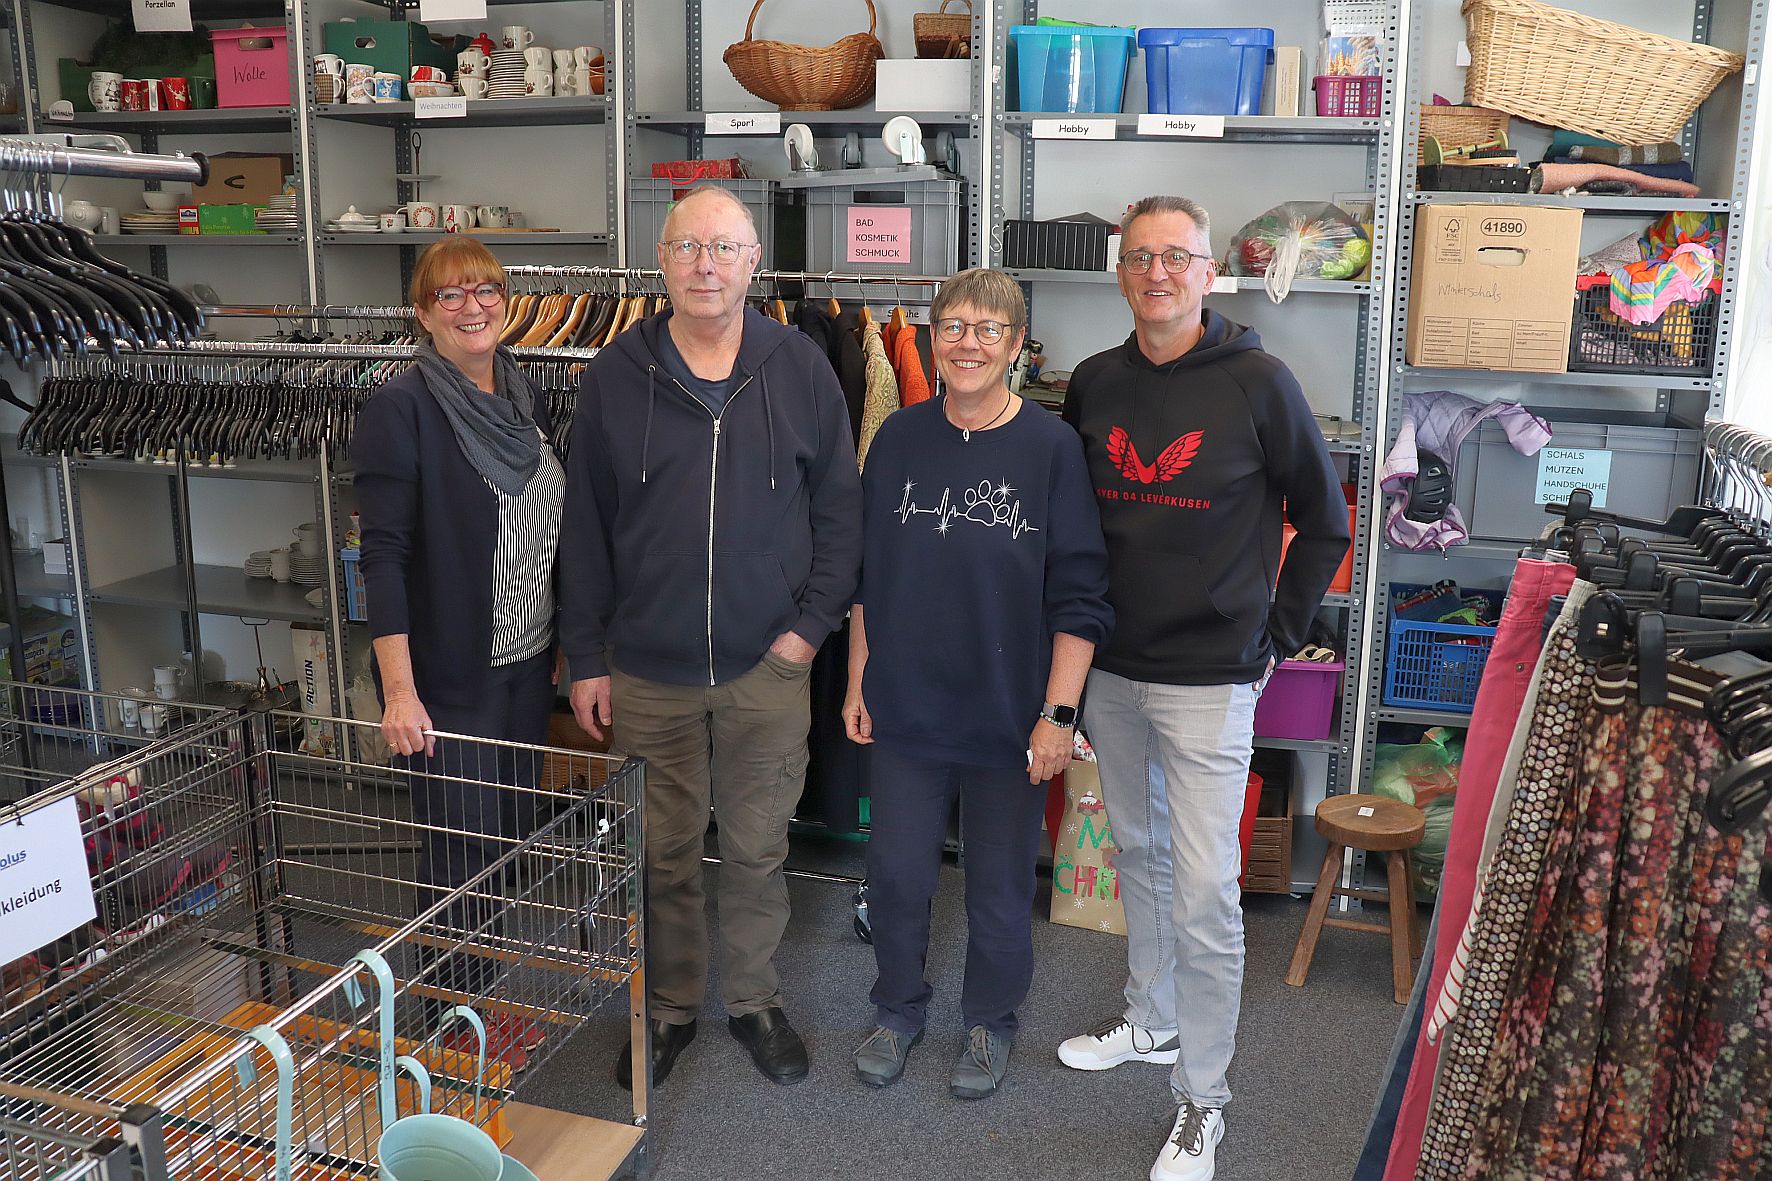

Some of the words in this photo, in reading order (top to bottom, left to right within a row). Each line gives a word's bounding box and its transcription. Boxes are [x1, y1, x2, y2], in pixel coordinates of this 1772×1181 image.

[145, 0, 176, 8] Porzellan
[233, 62, 266, 84] Wolle
[420, 102, 462, 110] Weihnachten
[730, 119, 754, 129] Sport
[1164, 120, 1196, 132] Hobby
[1058, 124, 1089, 135] Hobby
[855, 218, 874, 227] BAD
[1484, 222, 1523, 233] 41890
[855, 233, 898, 242] KOSMETIK
[855, 248, 900, 257] SCHMUCK
[1546, 450, 1585, 460] SCHALS
[1544, 479, 1607, 491] HANDSCHUHE
[1123, 491, 1137, 501] 04
[1141, 492, 1211, 509] LEVERKUSEN
[304, 659, 314, 705] ACTION
